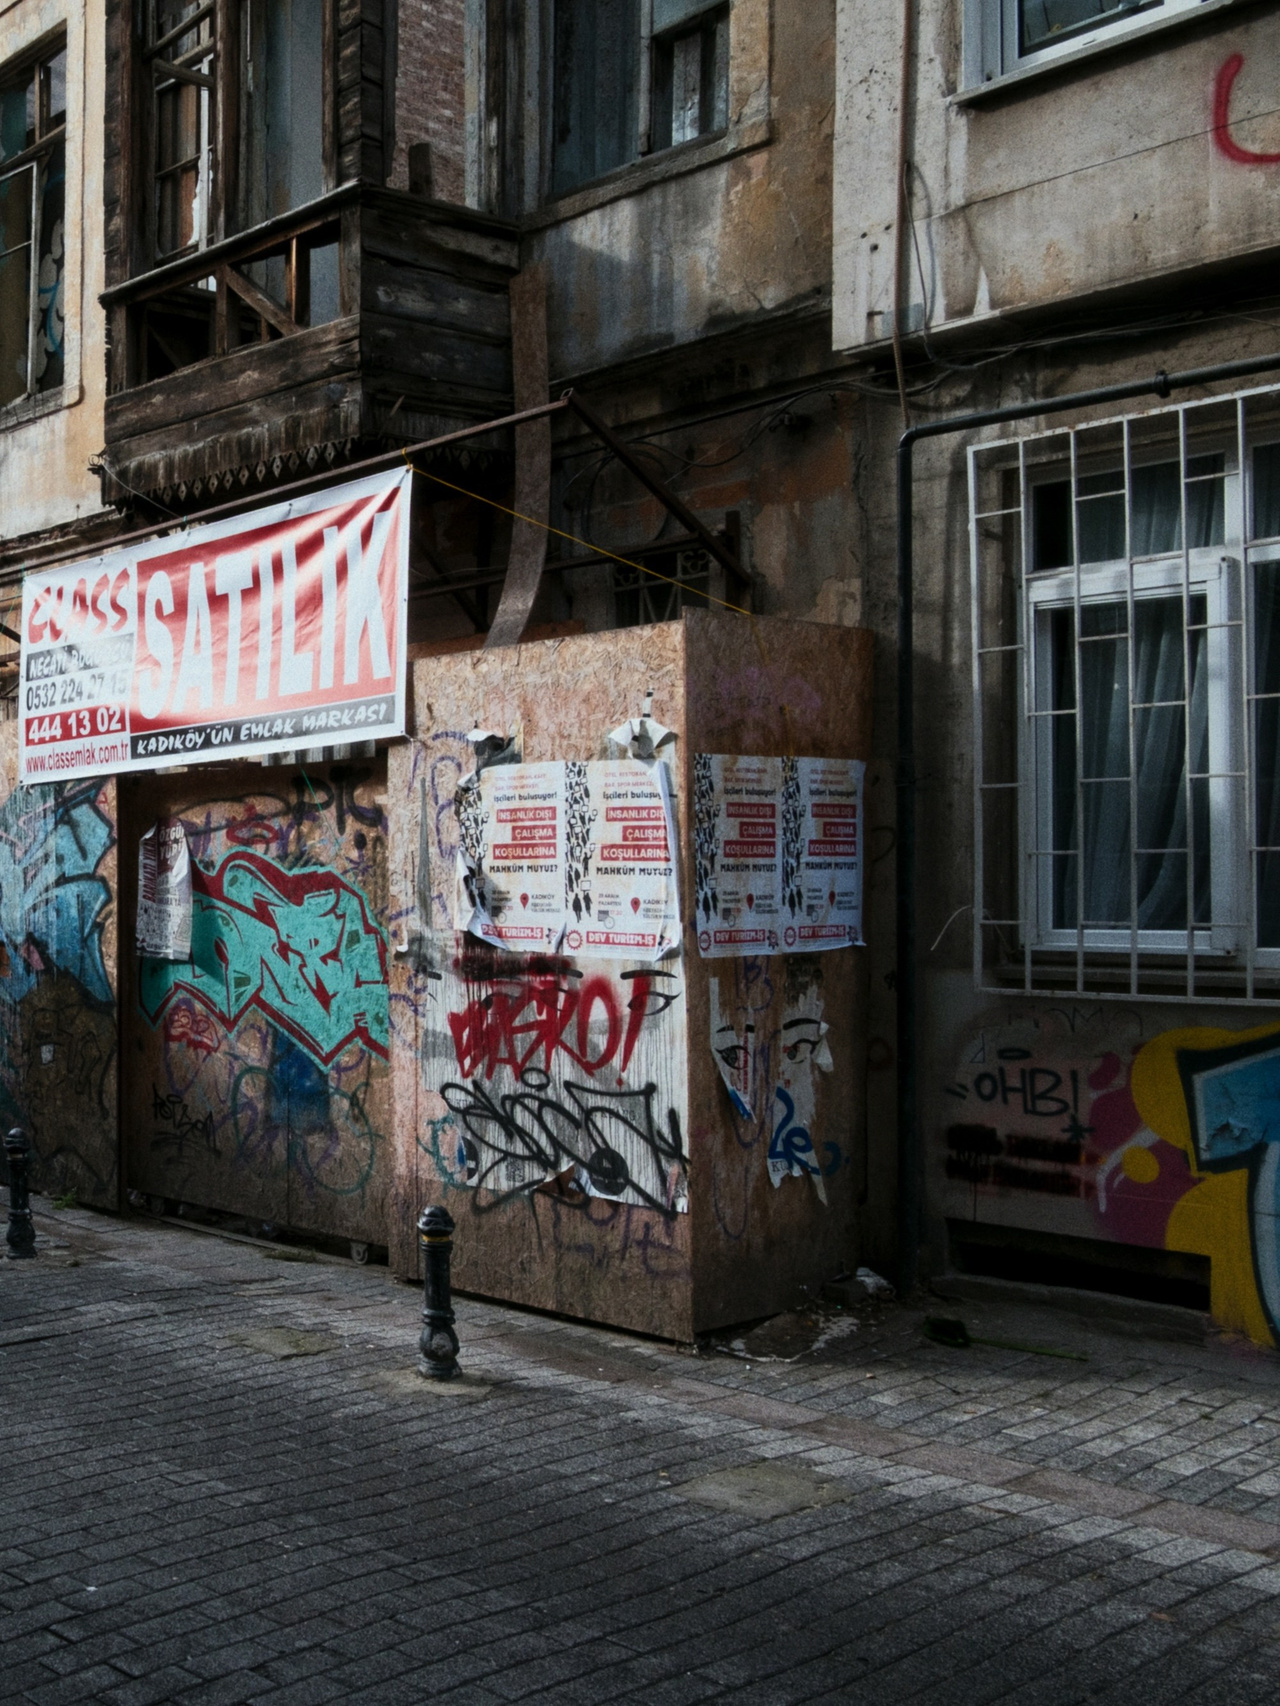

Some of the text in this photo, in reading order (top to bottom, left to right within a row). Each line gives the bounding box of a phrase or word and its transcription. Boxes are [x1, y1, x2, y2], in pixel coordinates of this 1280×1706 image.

[28, 567, 130, 644] CLASS
[138, 509, 392, 719] SATILIK
[26, 681, 57, 711] 0532
[60, 678, 84, 704] 224
[87, 672, 105, 699] 27
[28, 706, 122, 743] 444 13 02
[136, 702, 387, 755] KADIKÖY'ÜN EMLAK MARKASI
[25, 739, 129, 773] www.classemlak.com.tr
[497, 810, 535, 820] İNSANLIK
[607, 808, 665, 821] İNSANLIK DIŞ
[515, 828, 554, 840] ÇALIŞMA
[742, 826, 773, 838] ÇALIŞMA
[825, 826, 854, 837] ÇALIŞMA
[494, 846, 556, 859] KOŞULLARINA
[603, 848, 669, 861] KOŞULLARINA
[725, 844, 775, 858] KOŞULLARINA
[810, 844, 855, 856] KOŞULLARINA
[588, 932, 607, 943] DEV
[715, 931, 730, 942] DEV
